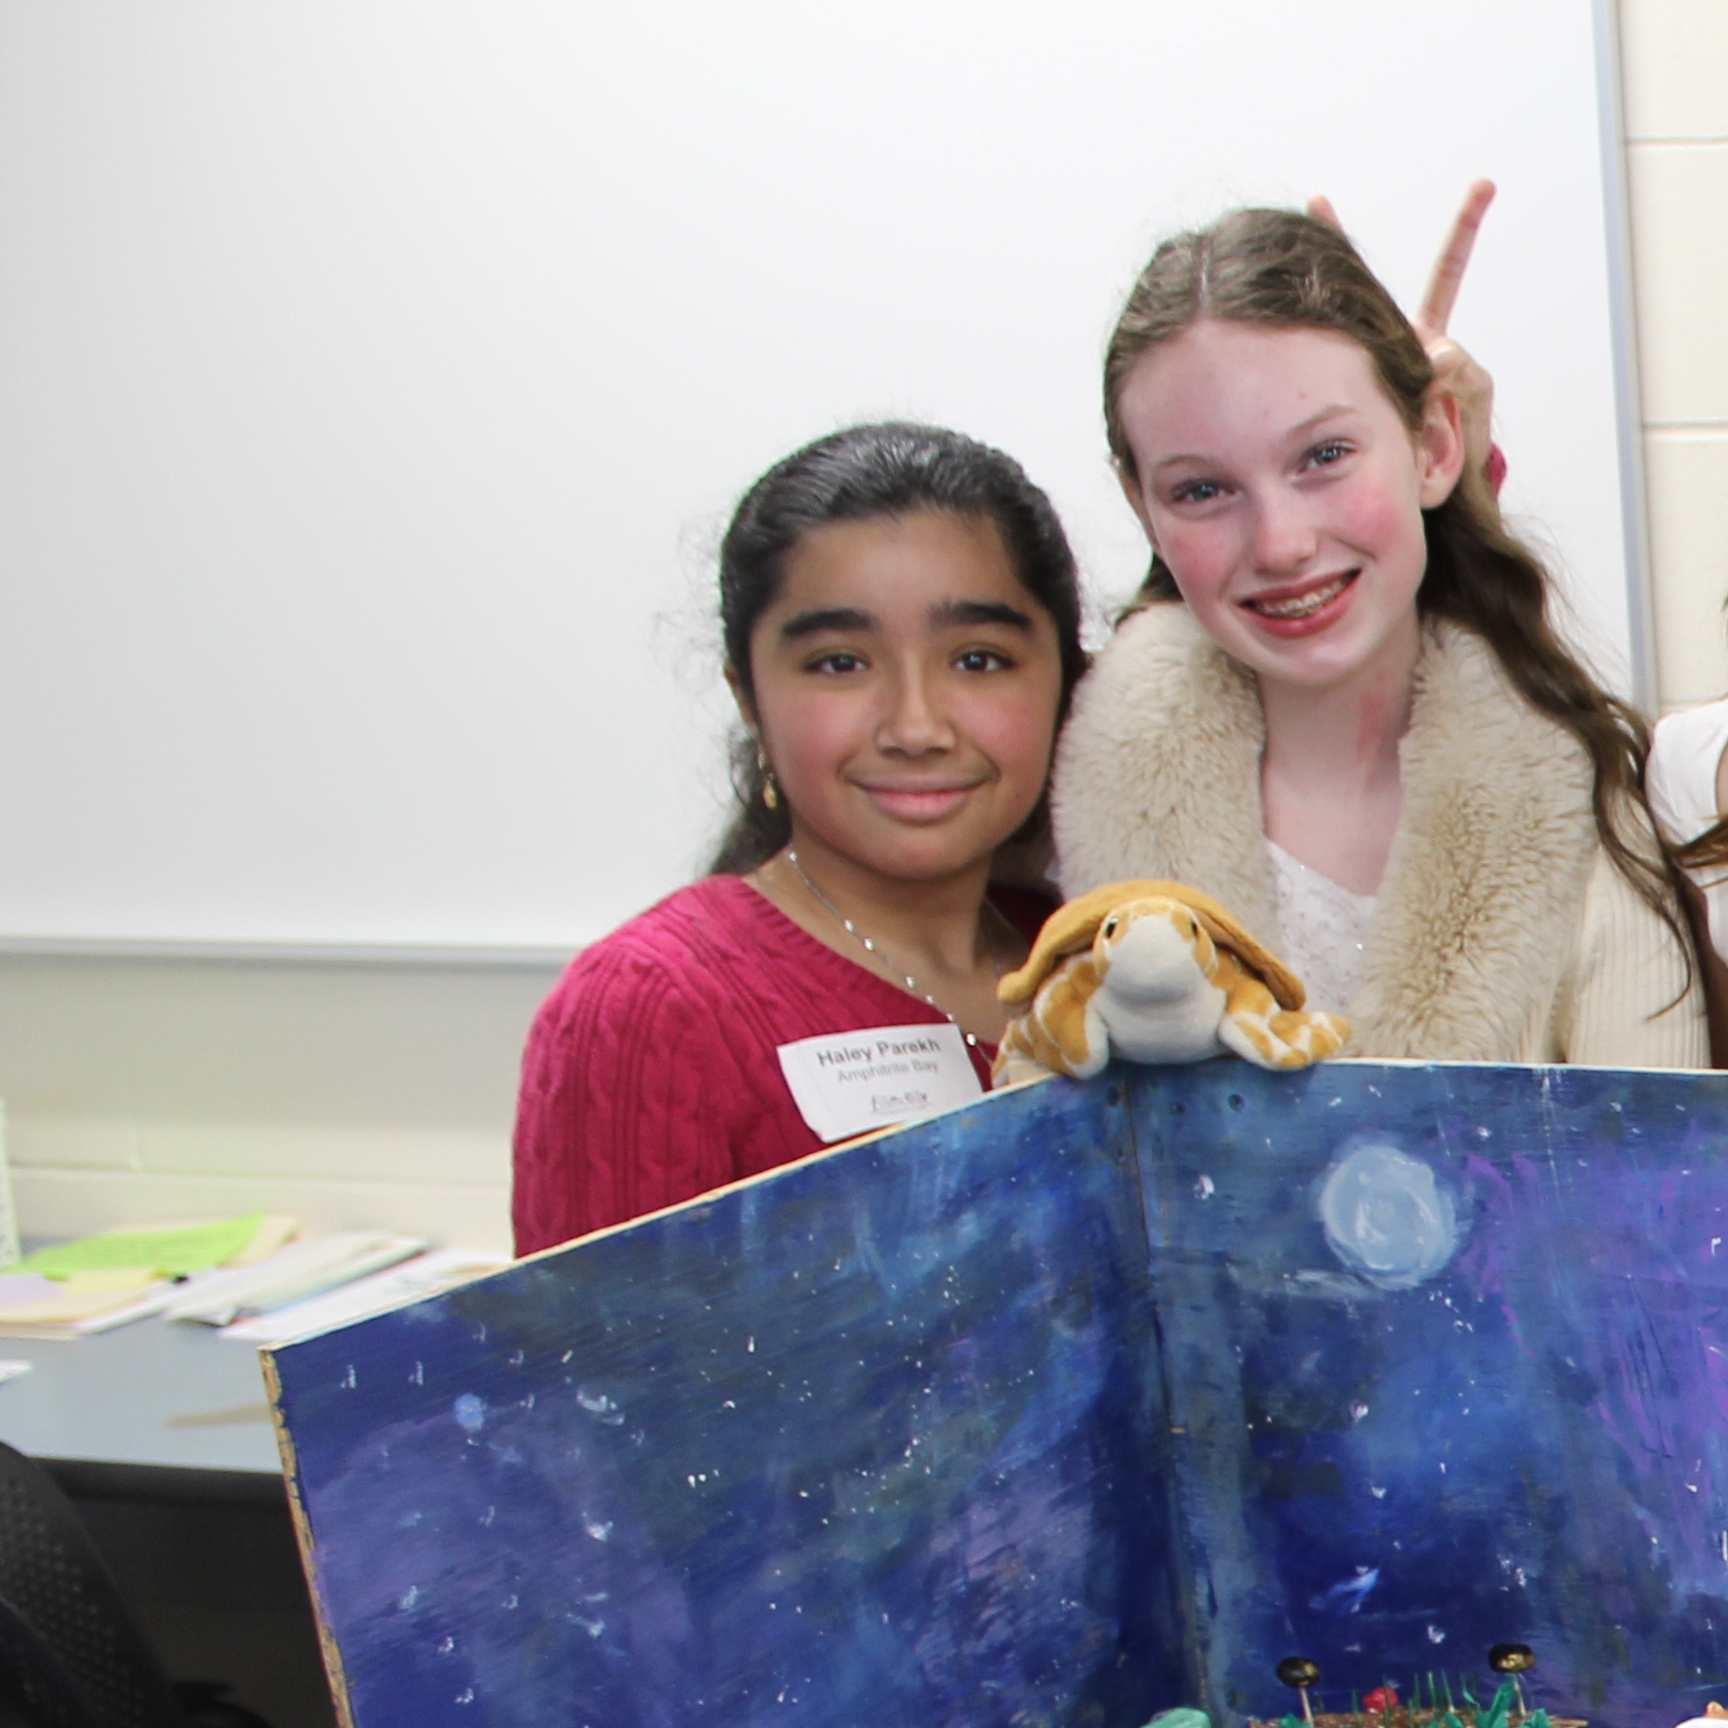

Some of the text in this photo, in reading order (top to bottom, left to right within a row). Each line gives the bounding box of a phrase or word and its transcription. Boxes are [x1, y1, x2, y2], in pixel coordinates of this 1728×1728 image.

[816, 1037, 941, 1067] Haley Parekh
[912, 1059, 939, 1074] Bay
